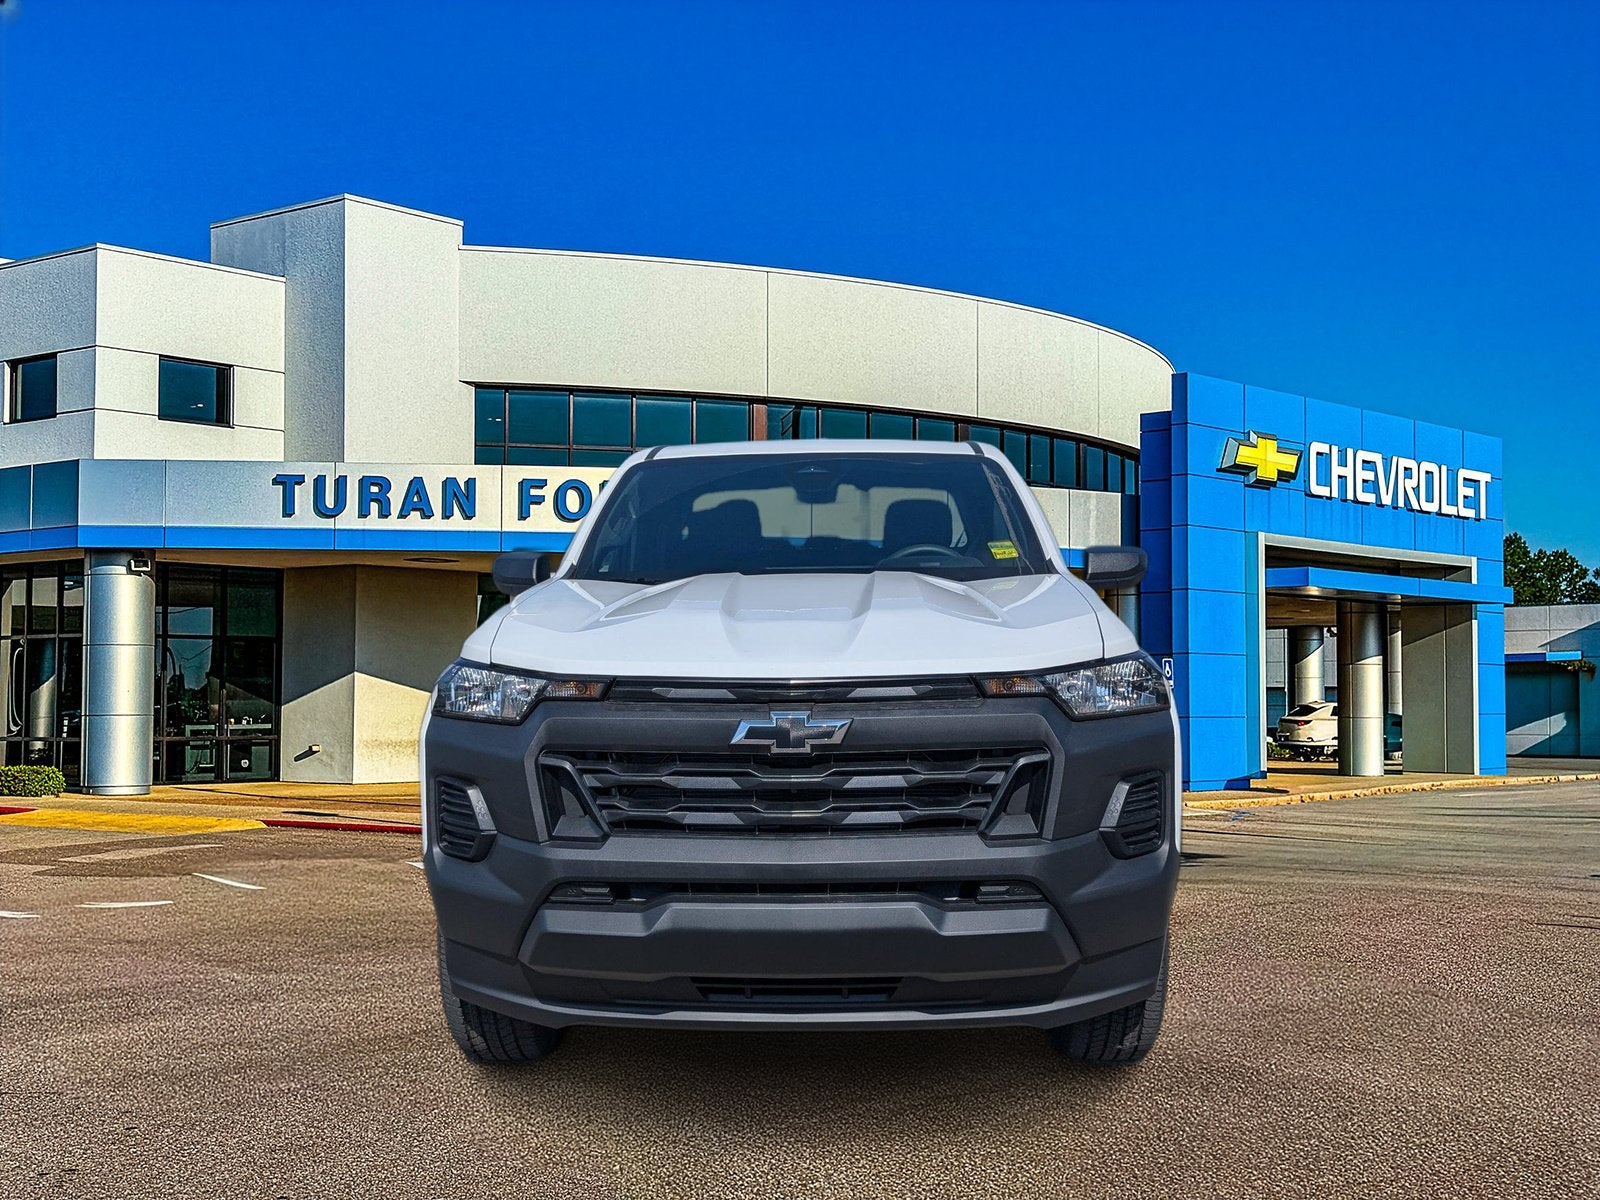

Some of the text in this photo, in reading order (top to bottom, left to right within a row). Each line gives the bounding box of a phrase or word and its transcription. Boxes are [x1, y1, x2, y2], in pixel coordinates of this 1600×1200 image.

[272, 474, 609, 523] TURAN FO
[1307, 441, 1492, 520] CHEVROLET
